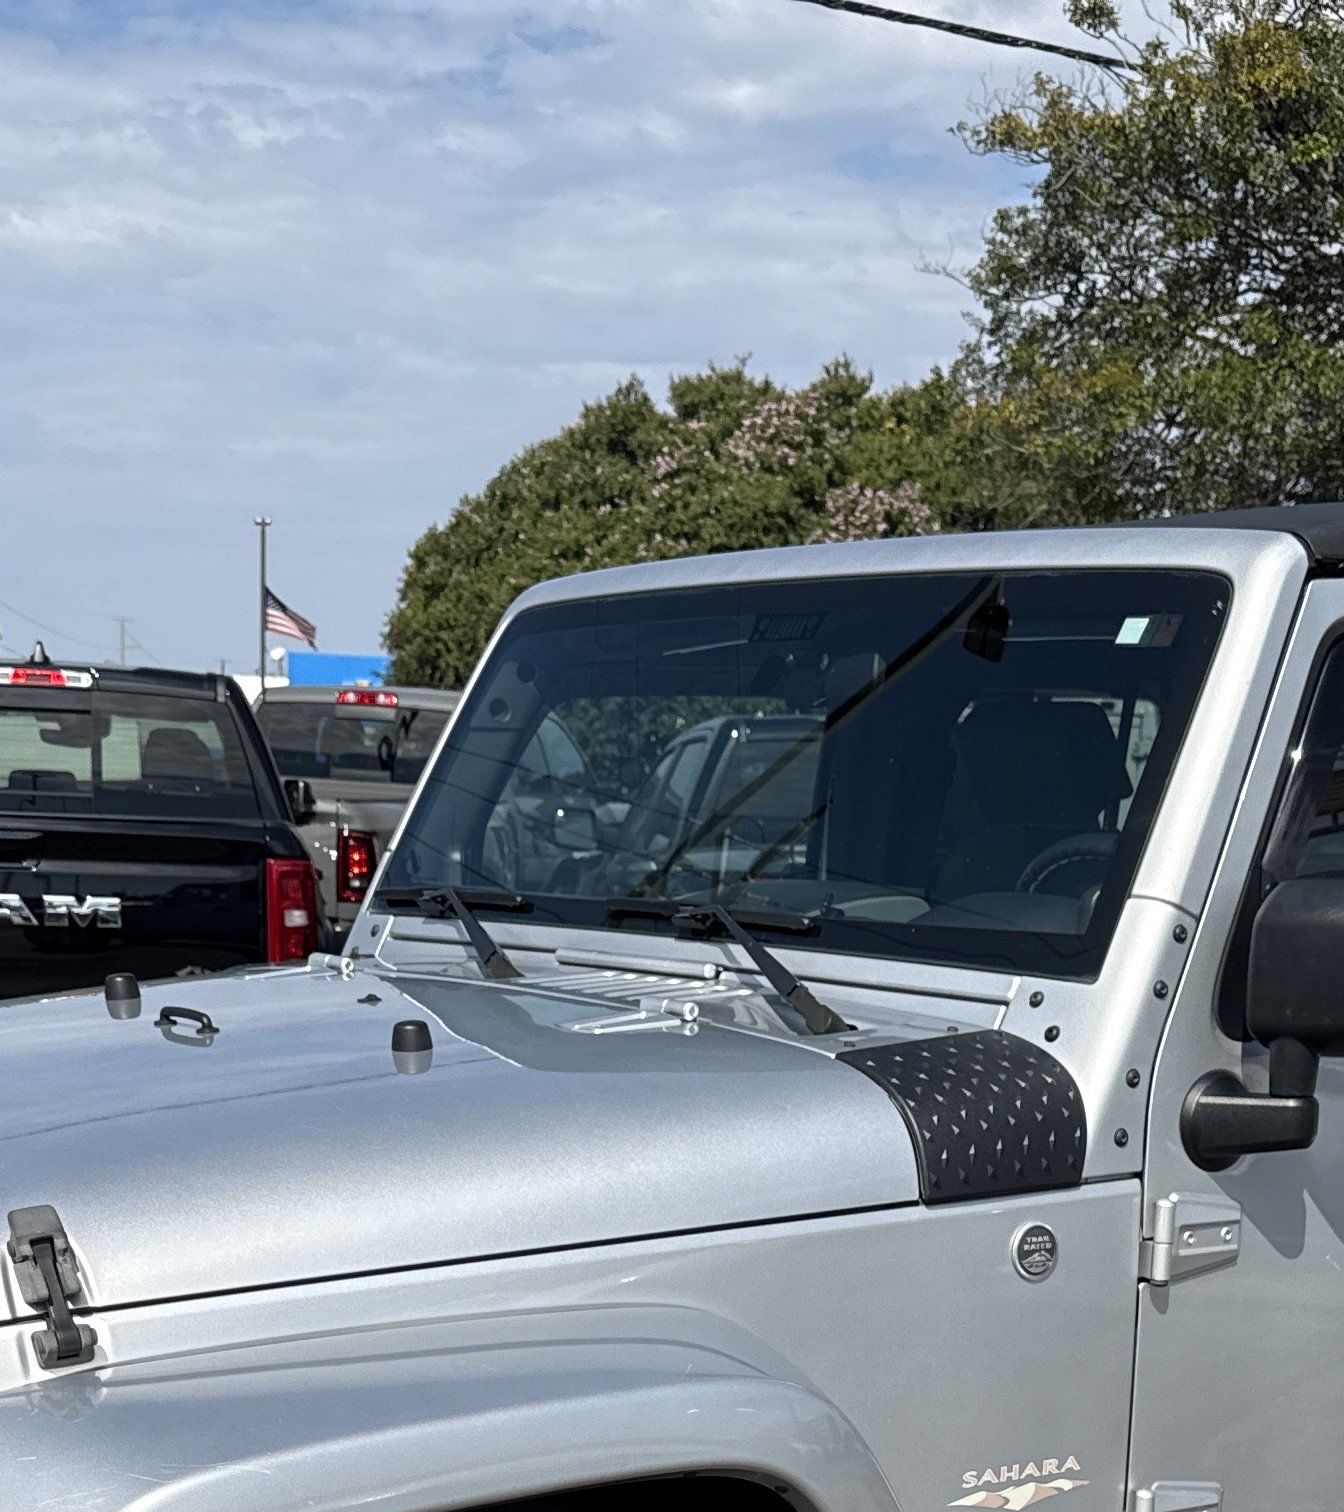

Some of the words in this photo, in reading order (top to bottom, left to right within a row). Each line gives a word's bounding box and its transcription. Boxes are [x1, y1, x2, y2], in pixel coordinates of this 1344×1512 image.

[1026, 1235, 1050, 1243] TRAIL
[1023, 1242, 1052, 1251] RATED
[962, 1455, 1081, 1488] SAHARA
